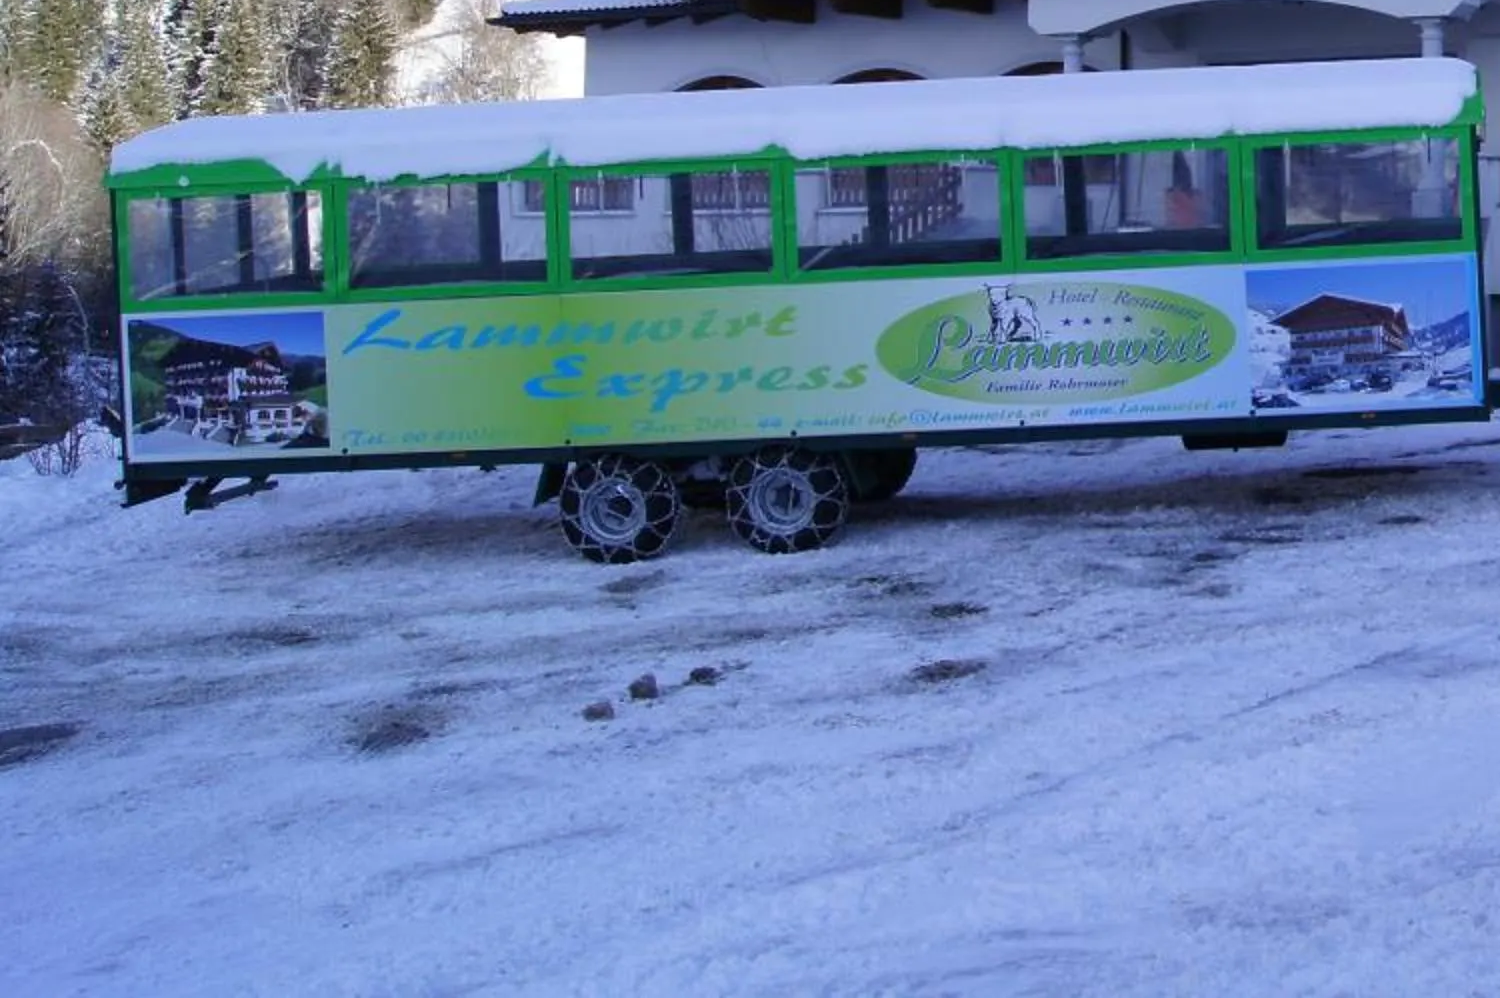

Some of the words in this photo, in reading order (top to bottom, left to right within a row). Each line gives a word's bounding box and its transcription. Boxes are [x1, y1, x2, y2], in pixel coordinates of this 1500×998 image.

[1048, 288, 1099, 305] Hotel
[342, 306, 797, 355] Lammwirt
[901, 314, 1213, 384] Lammwirt
[522, 354, 870, 413] Express
[985, 381, 1043, 394] Familie
